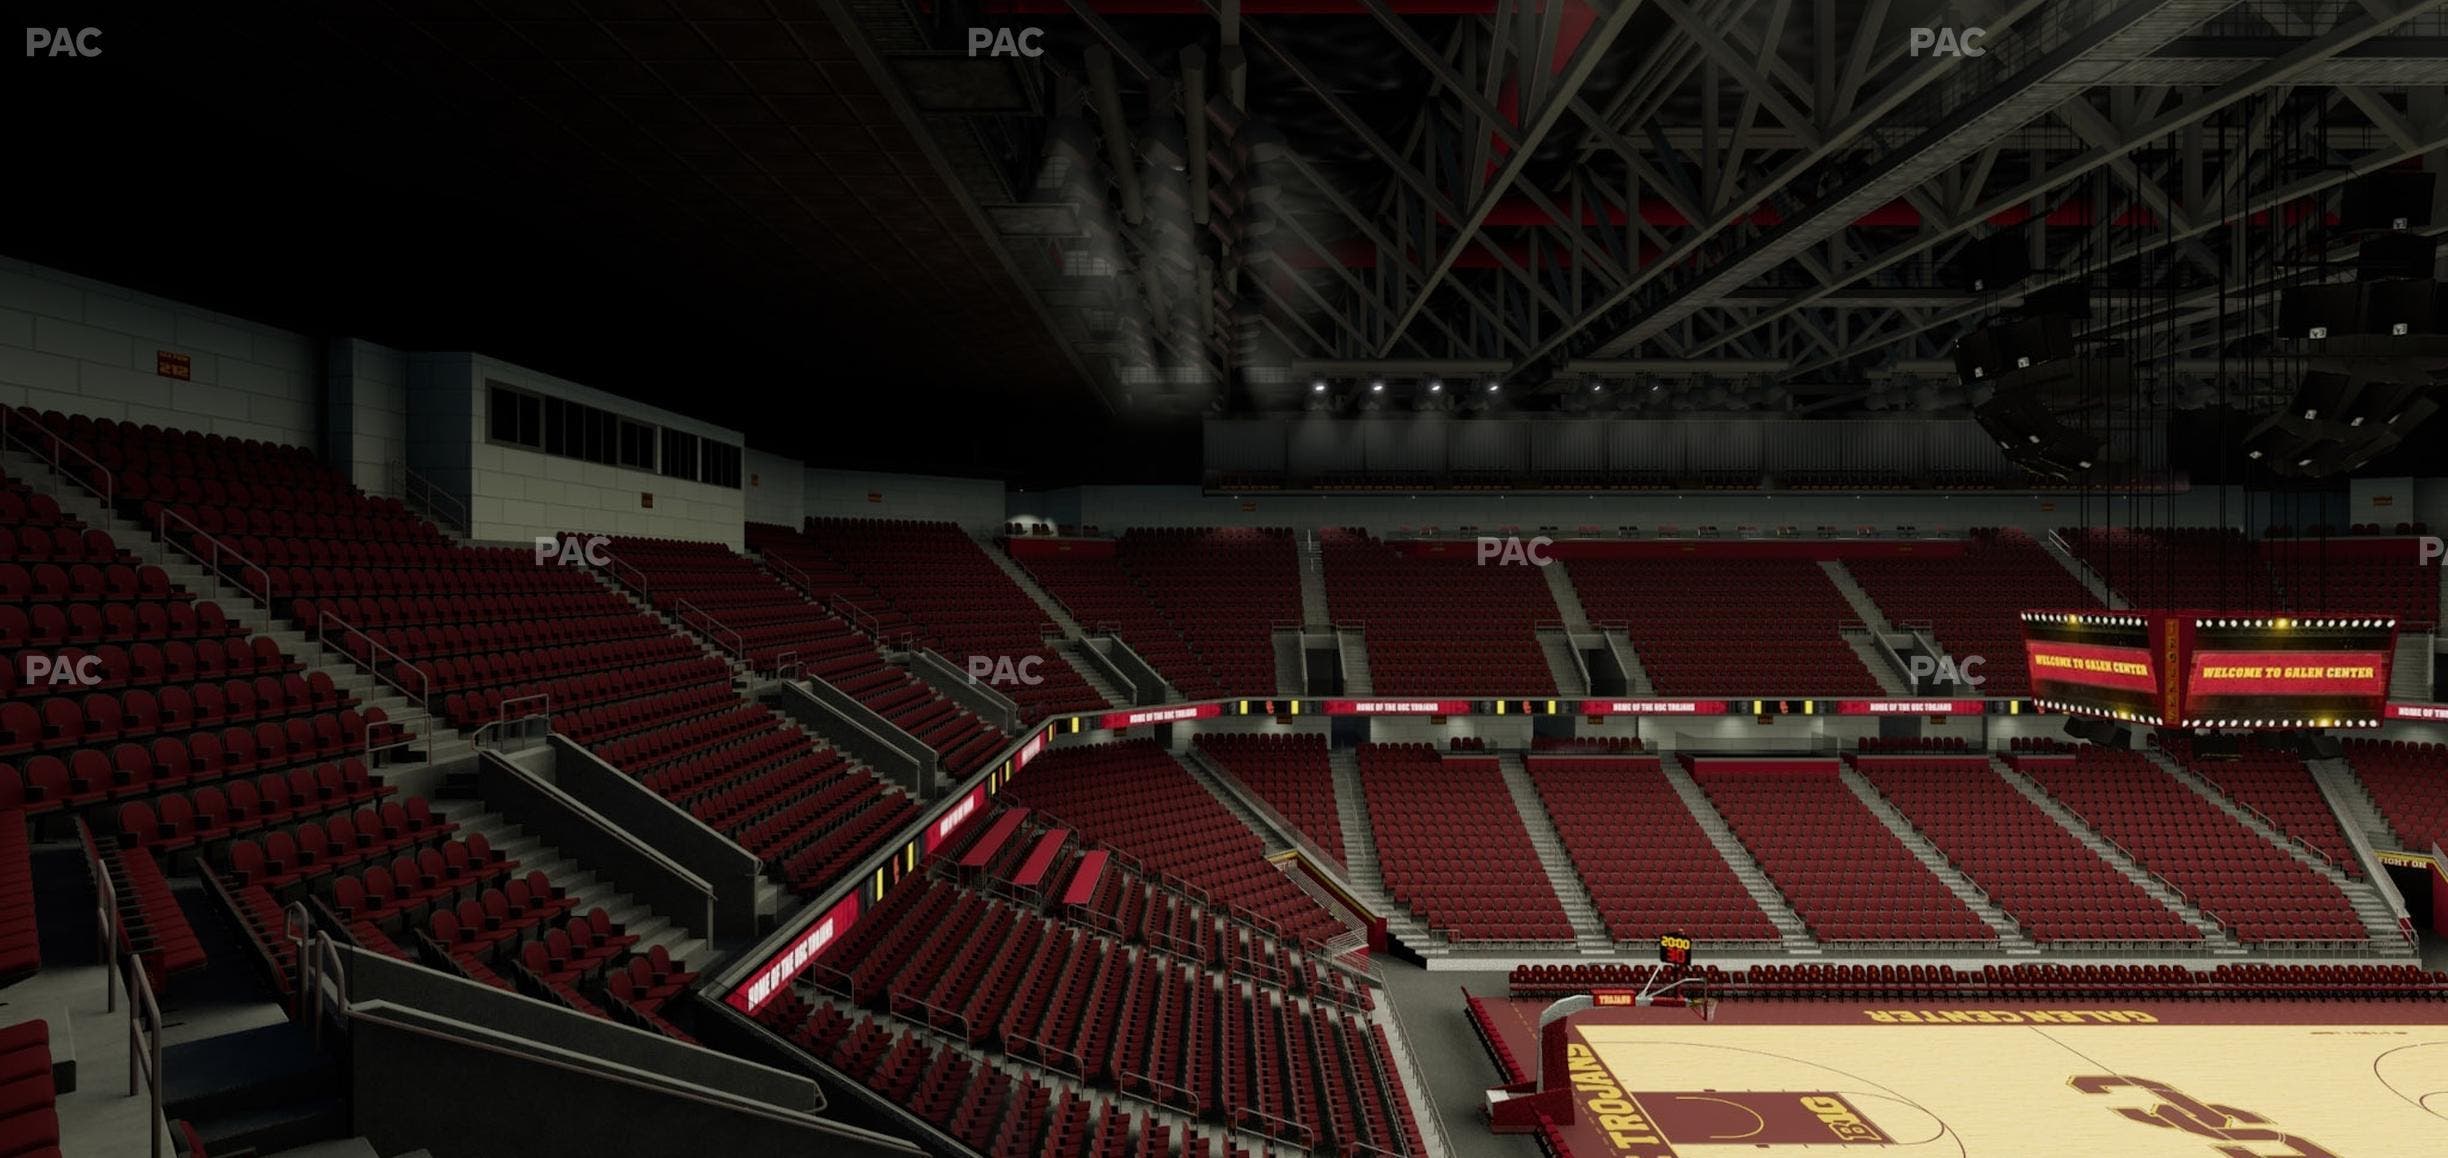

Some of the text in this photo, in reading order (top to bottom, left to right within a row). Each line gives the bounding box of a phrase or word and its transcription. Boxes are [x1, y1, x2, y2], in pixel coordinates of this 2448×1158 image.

[2035, 655, 2149, 676] WELCOME TO GALEN CENTER
[2203, 667, 2374, 678] WELCOME TO GALEN CENTER
[2411, 860, 2427, 869] ON
[1661, 935, 1690, 949] 20:00
[1667, 948, 1685, 963] 30
[1864, 1010, 2160, 1023] GALEN CENTER
